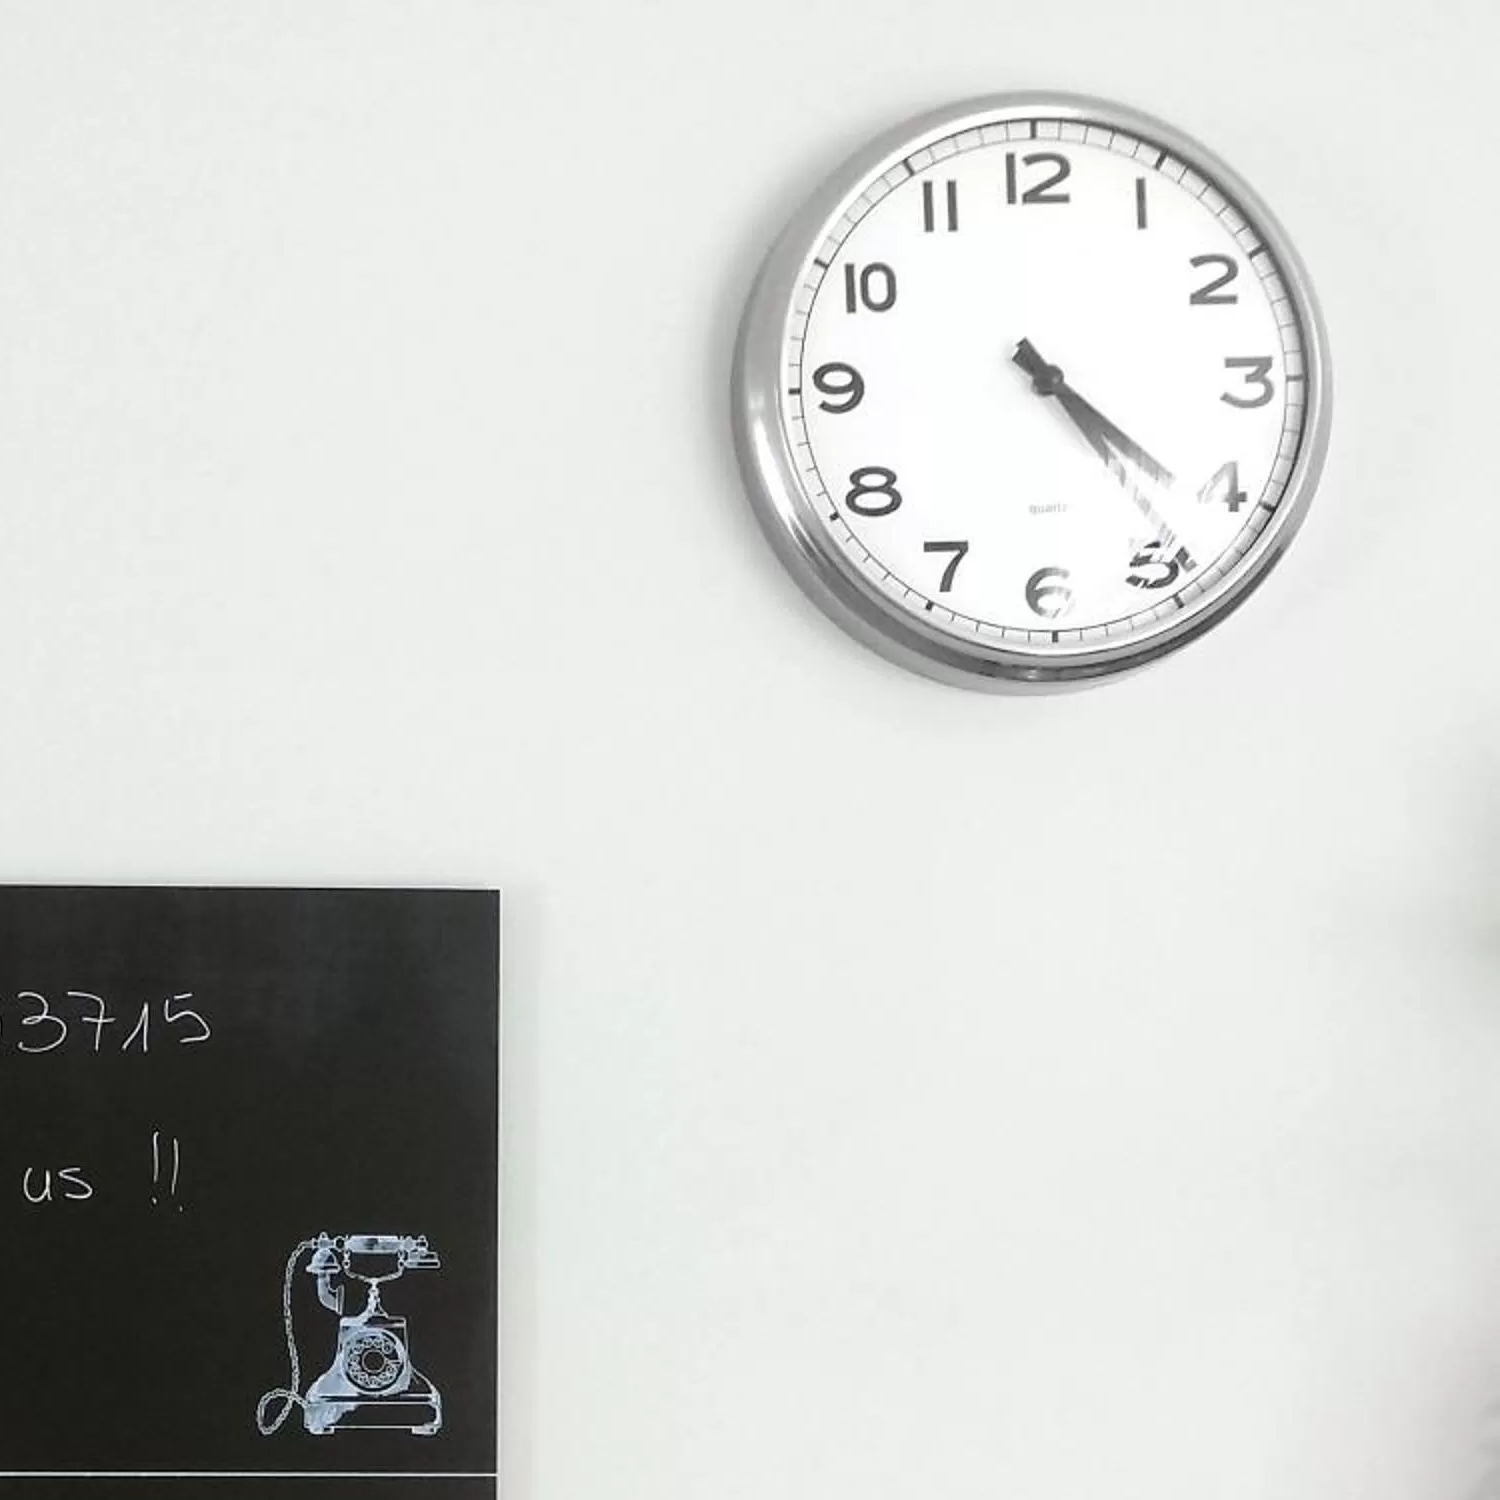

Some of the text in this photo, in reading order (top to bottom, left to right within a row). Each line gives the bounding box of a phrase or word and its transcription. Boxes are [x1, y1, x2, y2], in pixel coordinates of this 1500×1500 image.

[1004, 151, 1073, 206] 12
[1134, 175, 1149, 231] 1
[921, 179, 960, 233] 11
[842, 261, 899, 315] 10
[1187, 252, 1240, 306] 2
[810, 361, 867, 415] 9
[1218, 355, 1276, 410] 3
[843, 465, 904, 518] 8
[1195, 460, 1248, 513] 4
[921, 539, 970, 593] 7
[1023, 566, 1075, 618] 6
[22, 1166, 94, 1202] us
